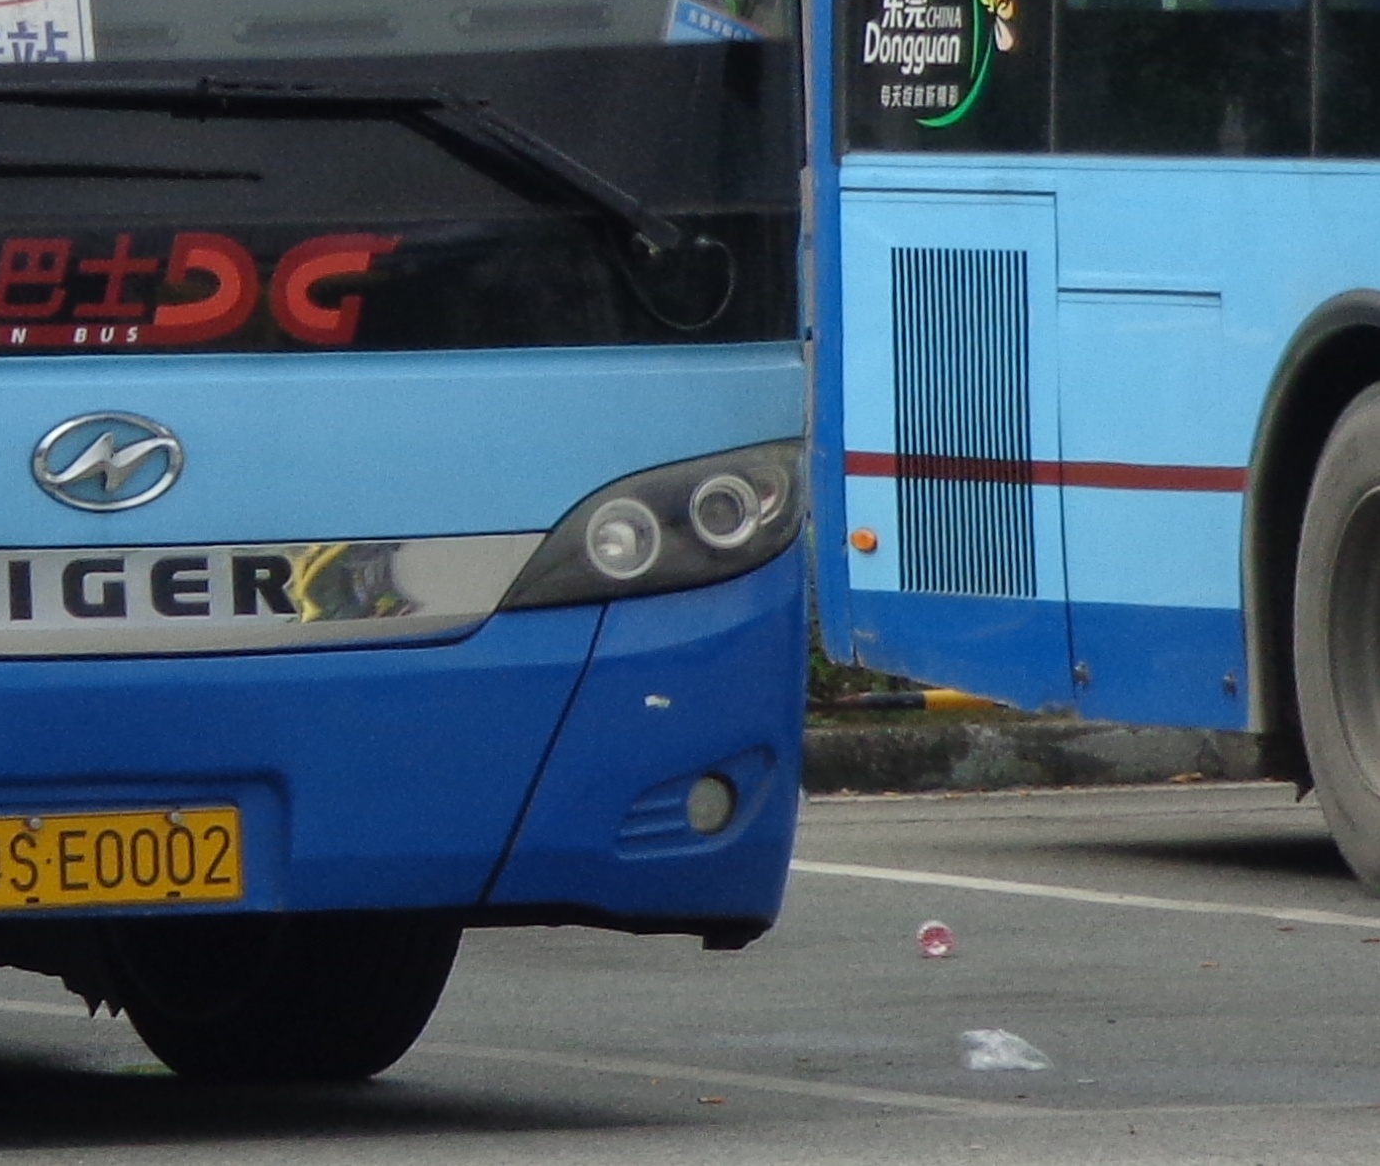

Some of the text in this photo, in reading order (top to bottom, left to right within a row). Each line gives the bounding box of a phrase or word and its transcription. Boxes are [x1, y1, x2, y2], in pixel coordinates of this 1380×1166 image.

[926, 6, 962, 28] CHINA
[864, 21, 960, 75] Dongguan
[74, 326, 139, 344] BUS
